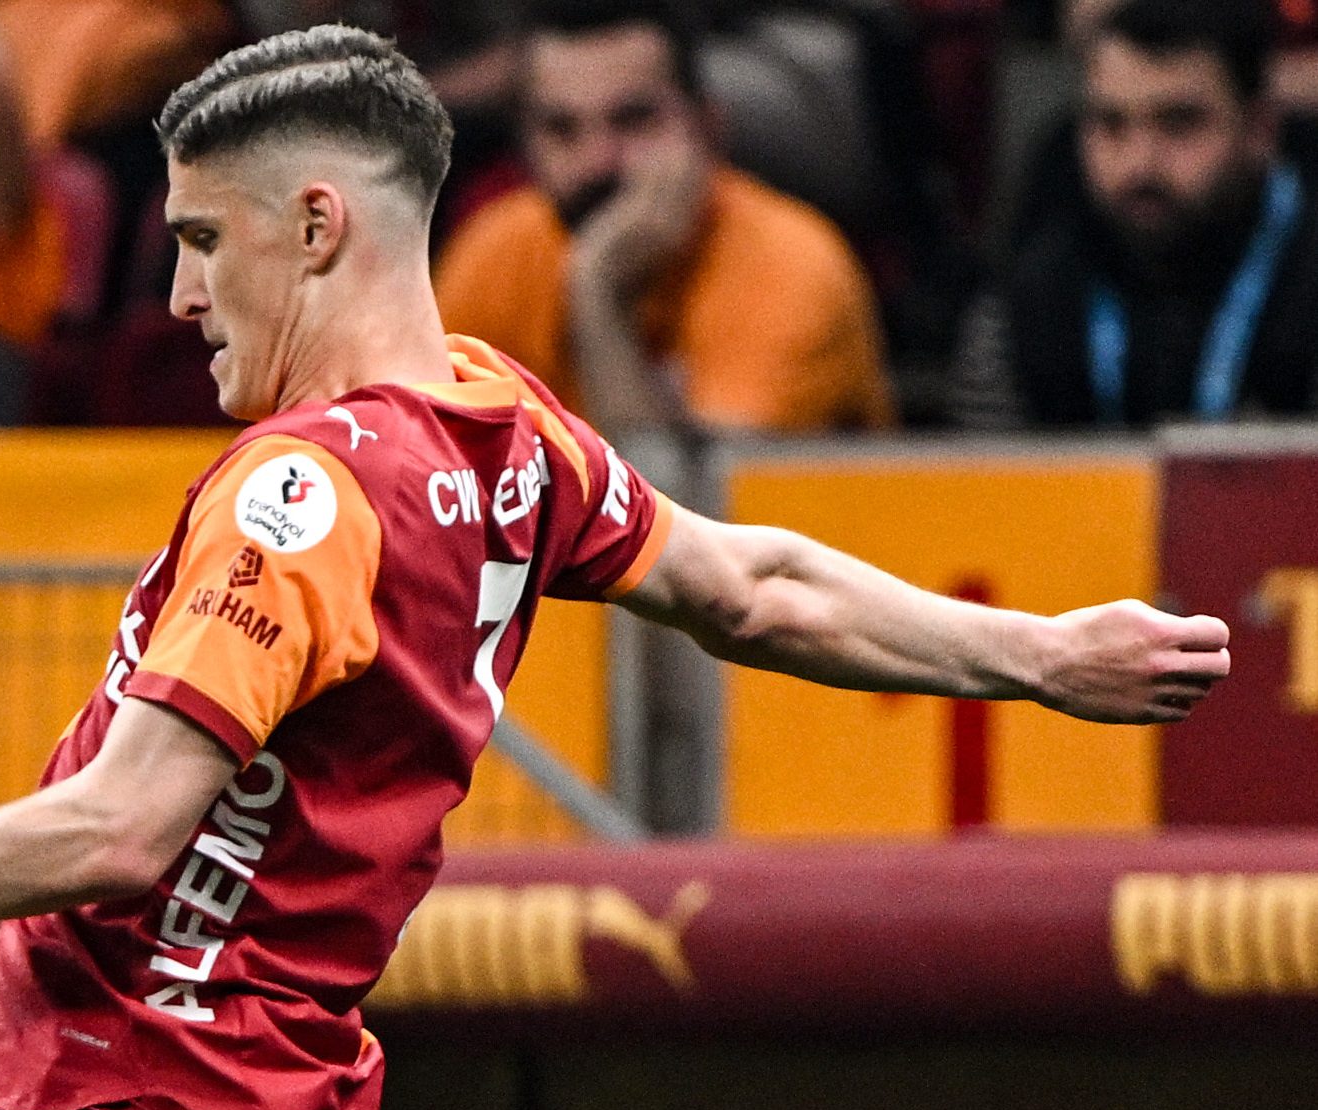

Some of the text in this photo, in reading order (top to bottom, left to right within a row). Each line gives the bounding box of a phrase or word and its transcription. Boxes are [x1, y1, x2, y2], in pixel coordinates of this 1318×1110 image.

[427, 469, 482, 526] CW
[474, 557, 533, 723] 7
[145, 750, 285, 1023] ALFEMO
